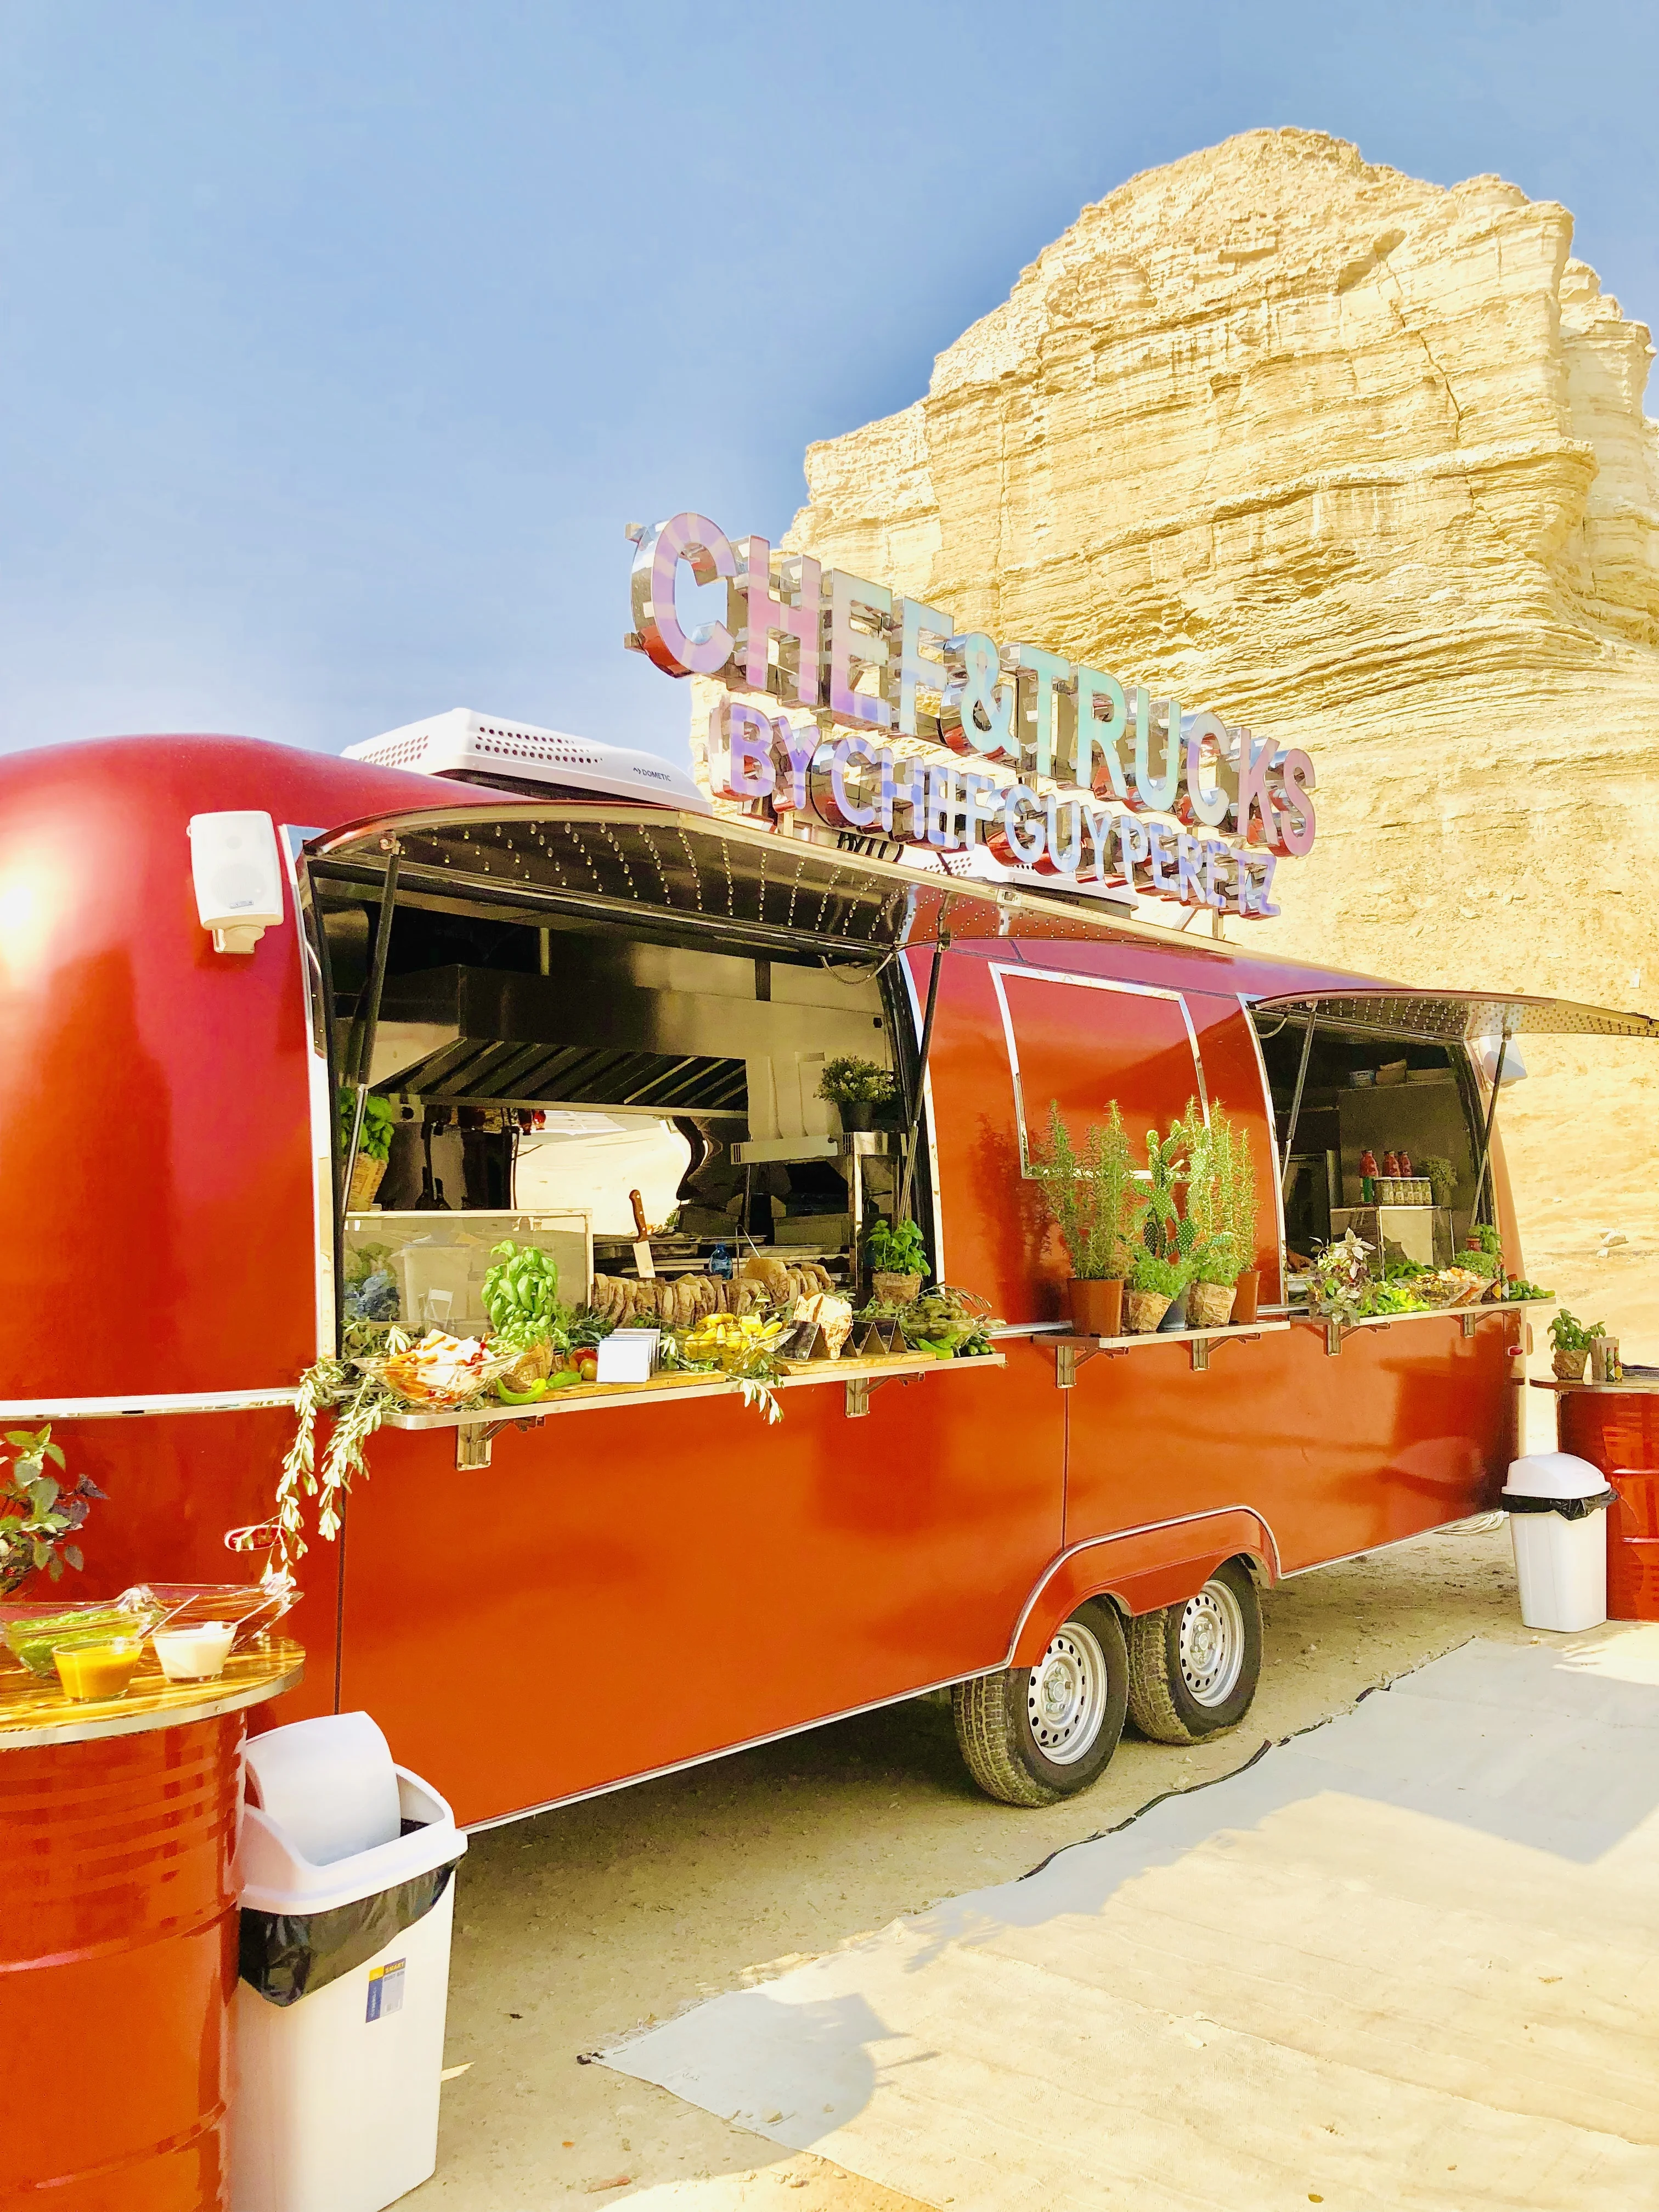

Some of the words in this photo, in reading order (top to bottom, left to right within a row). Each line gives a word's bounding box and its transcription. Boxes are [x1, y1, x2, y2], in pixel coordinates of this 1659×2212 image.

[641, 769, 672, 782] DOMETIC
[647, 512, 955, 736] CHEF
[959, 631, 1022, 760] &
[1018, 642, 1316, 857] TRUCKS
[729, 703, 821, 809] BY
[831, 736, 995, 852] CHEF
[1003, 785, 1113, 881] GUY
[1119, 815, 1281, 916] PERETZ
